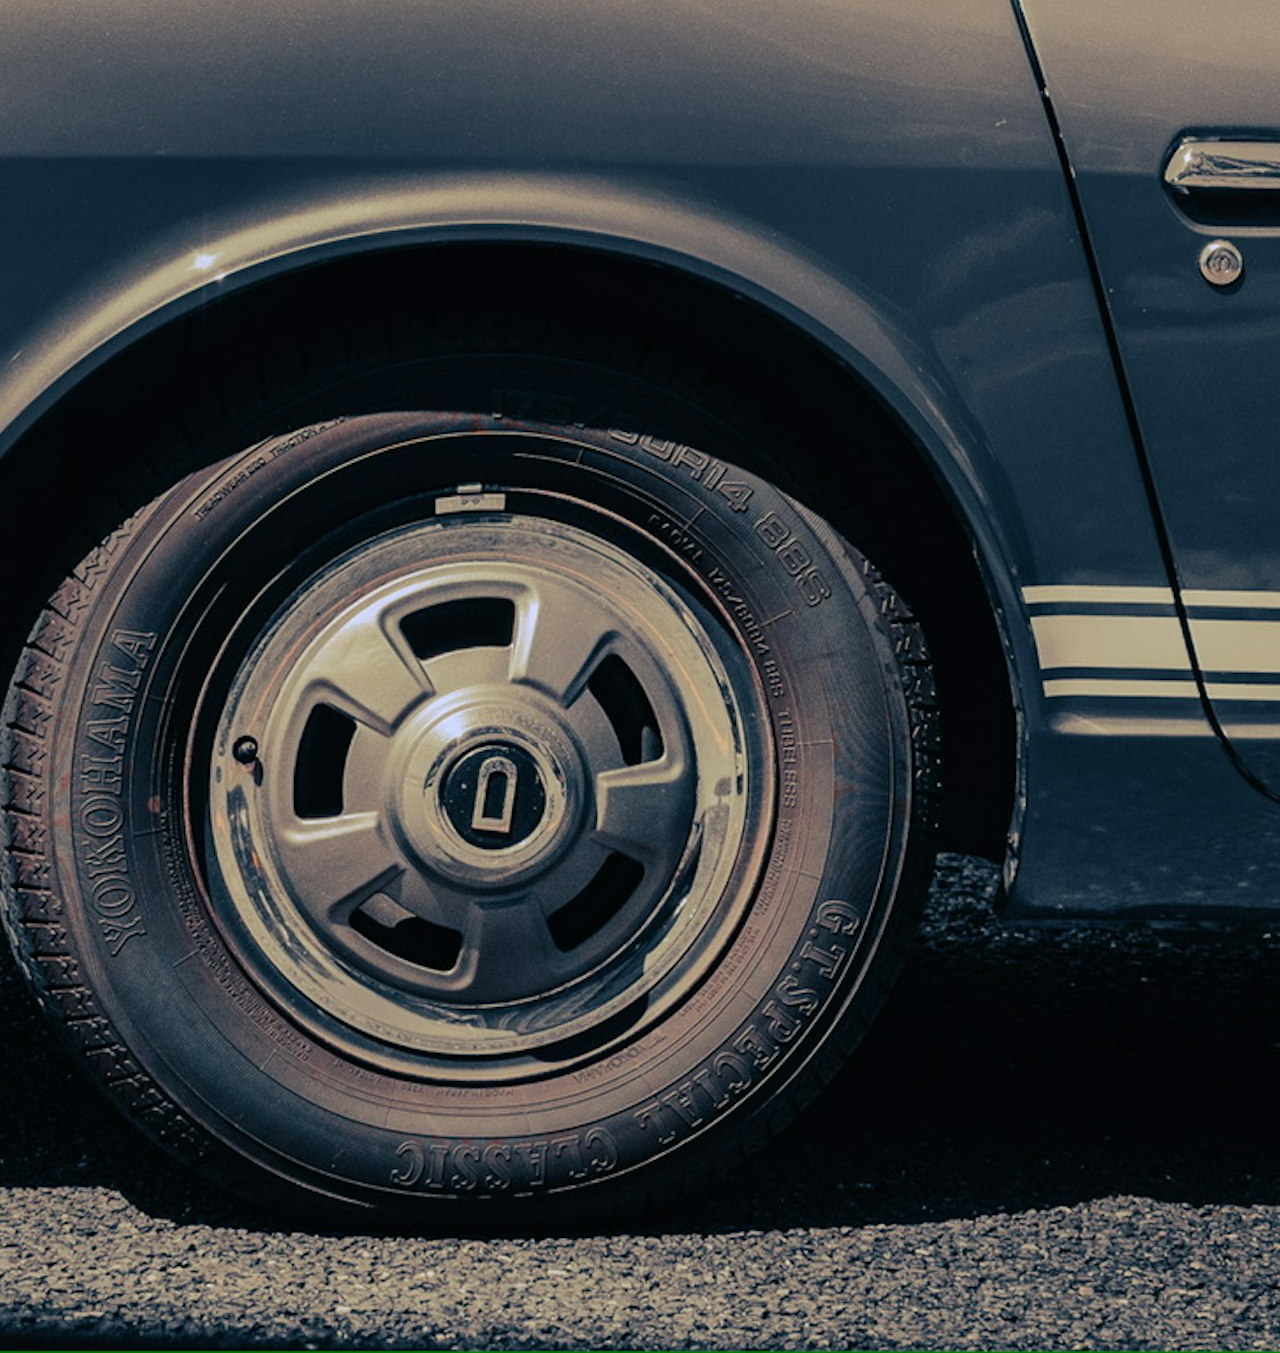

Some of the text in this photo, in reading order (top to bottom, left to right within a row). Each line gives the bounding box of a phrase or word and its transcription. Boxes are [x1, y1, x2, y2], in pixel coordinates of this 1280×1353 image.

[754, 512, 831, 607] 88S
[81, 628, 156, 956] YOKOHAMA
[777, 708, 796, 808] TUBELESS
[391, 1127, 621, 1192] CLASSIC
